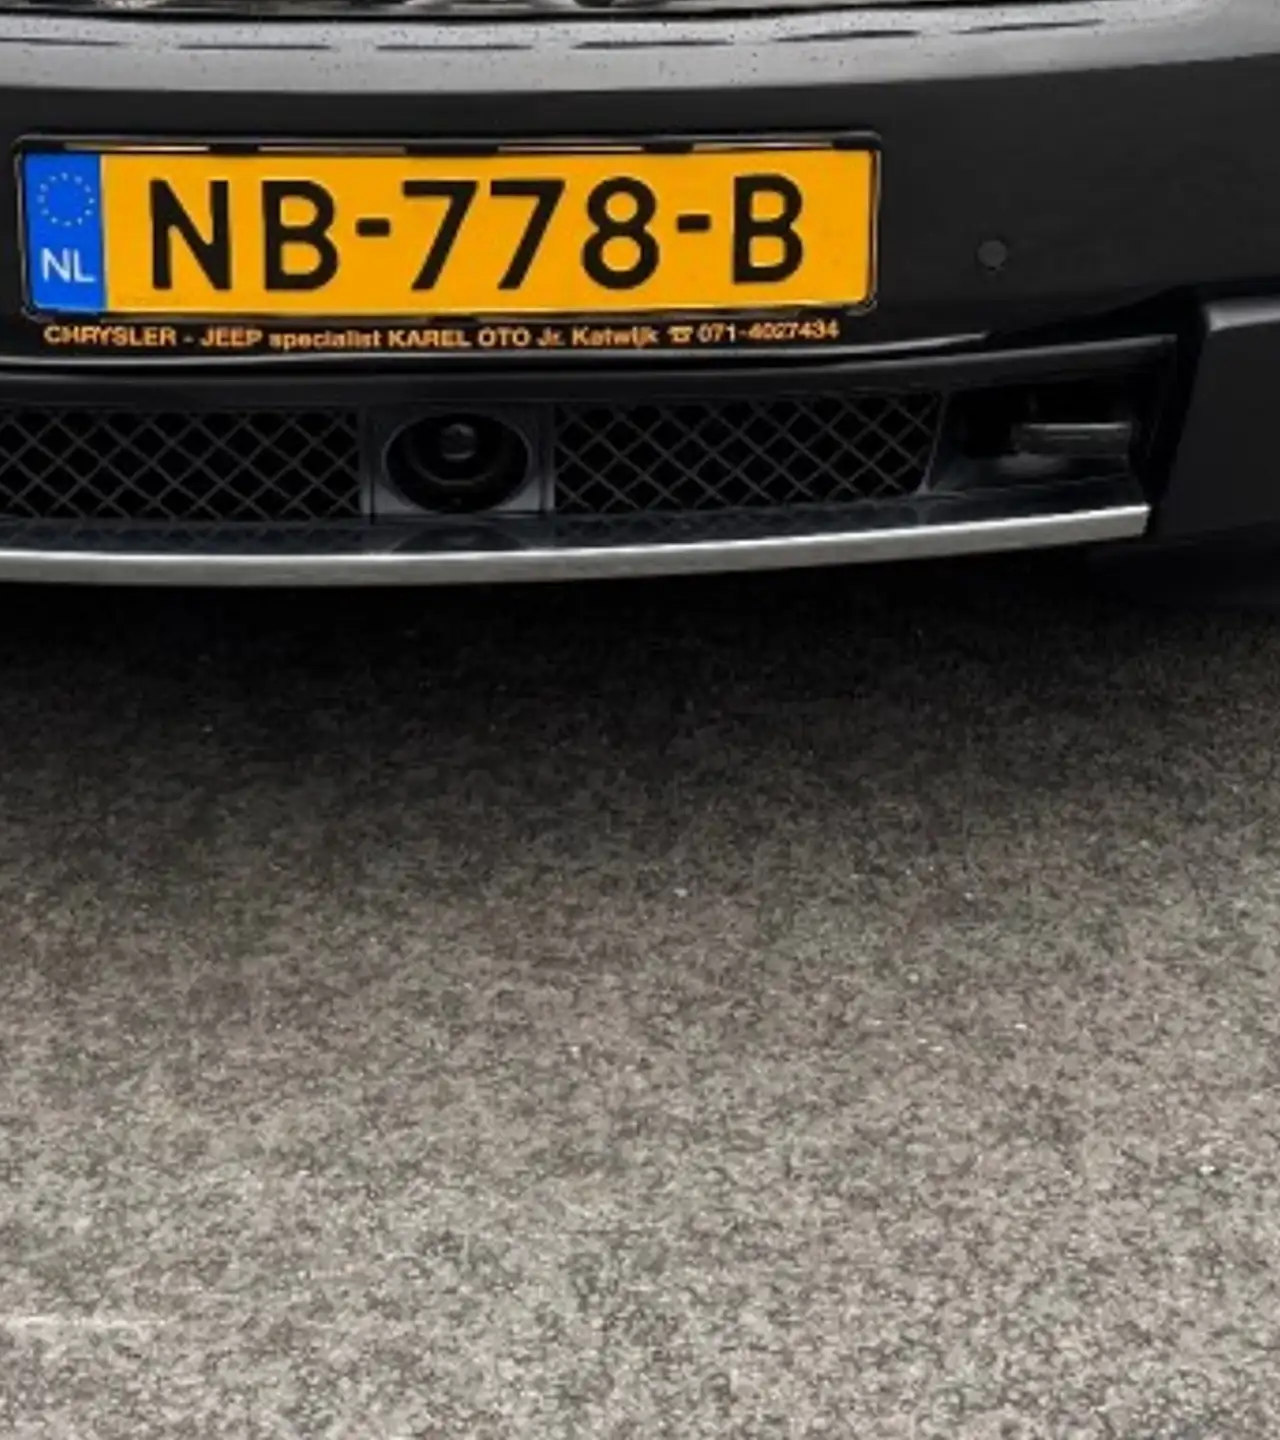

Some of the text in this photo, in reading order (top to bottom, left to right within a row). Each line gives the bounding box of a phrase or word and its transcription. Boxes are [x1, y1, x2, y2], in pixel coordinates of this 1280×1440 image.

[149, 173, 804, 292] NB-778-B
[40, 247, 97, 283] NL
[43, 325, 177, 347] CHRYSLER
[200, 327, 263, 347] JEEP
[269, 328, 381, 351] specialist
[387, 329, 471, 348] KAREL
[477, 327, 531, 348] OTO
[572, 326, 659, 349] Katwijk
